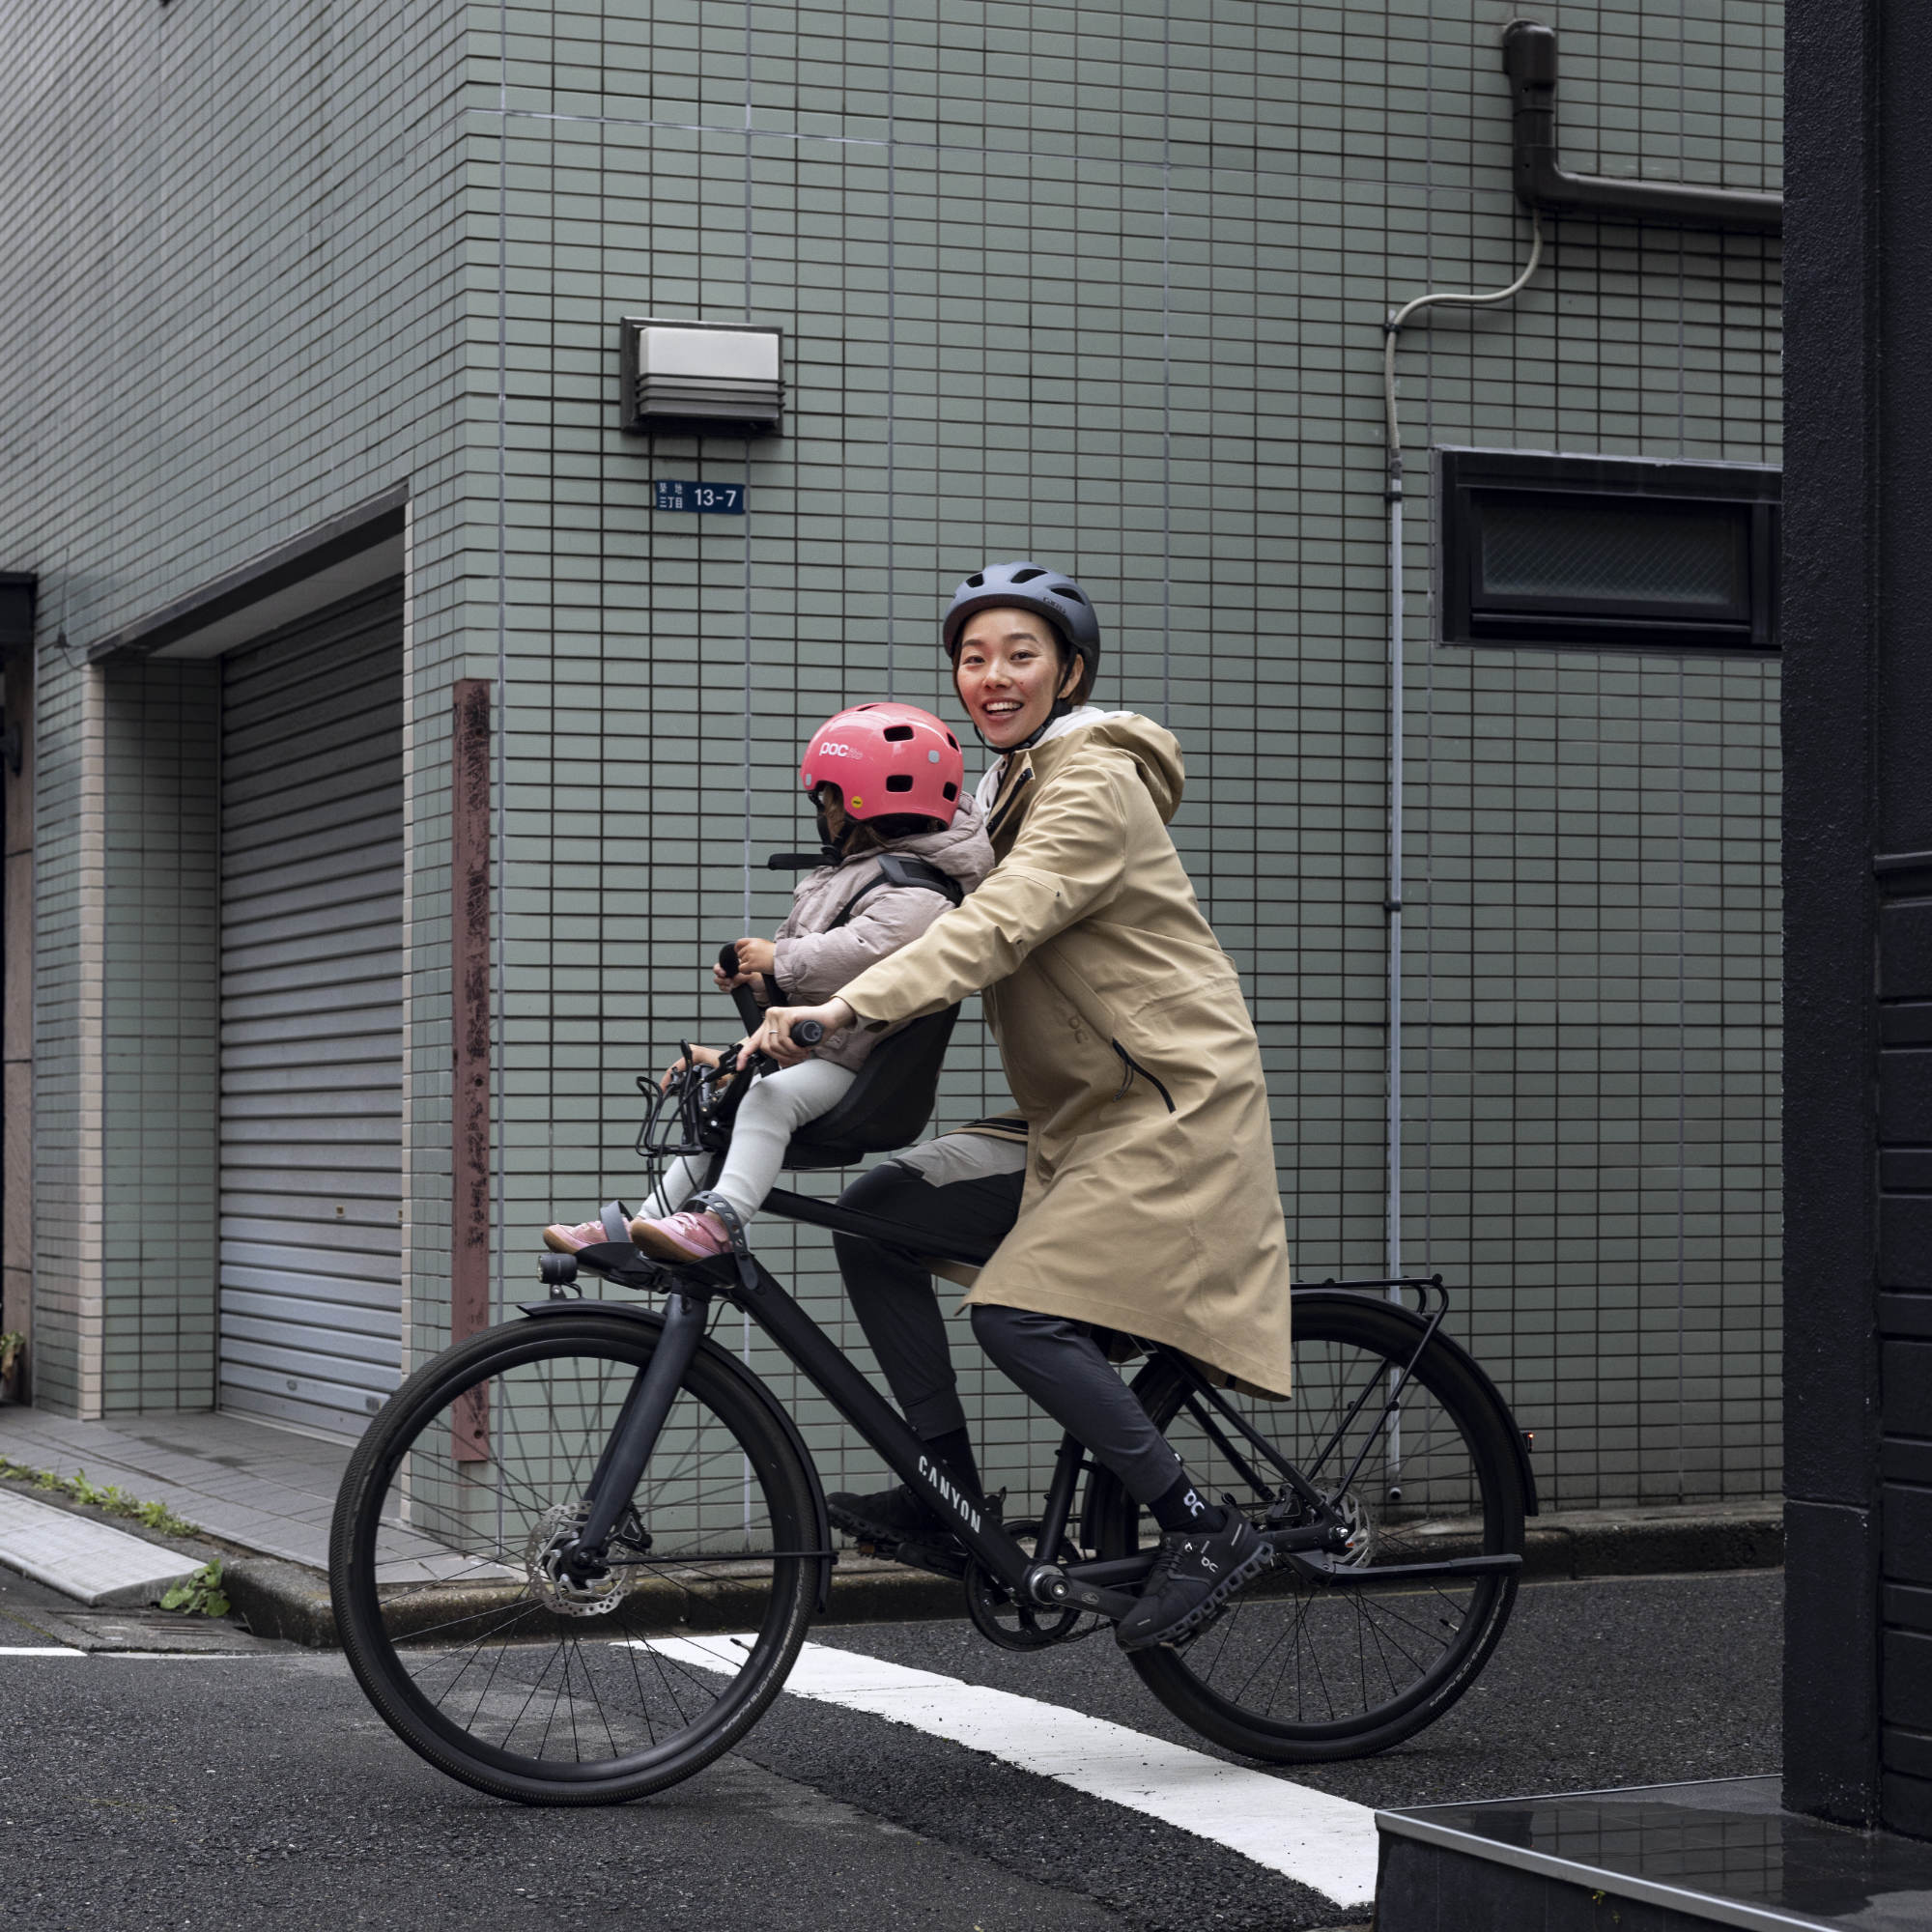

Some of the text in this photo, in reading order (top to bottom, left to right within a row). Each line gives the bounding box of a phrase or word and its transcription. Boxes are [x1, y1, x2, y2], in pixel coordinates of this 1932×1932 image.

[659, 496, 684, 509] 三丁目
[695, 489, 736, 507] 13-7
[819, 742, 849, 757] POC
[919, 1455, 980, 1534] CANYON
